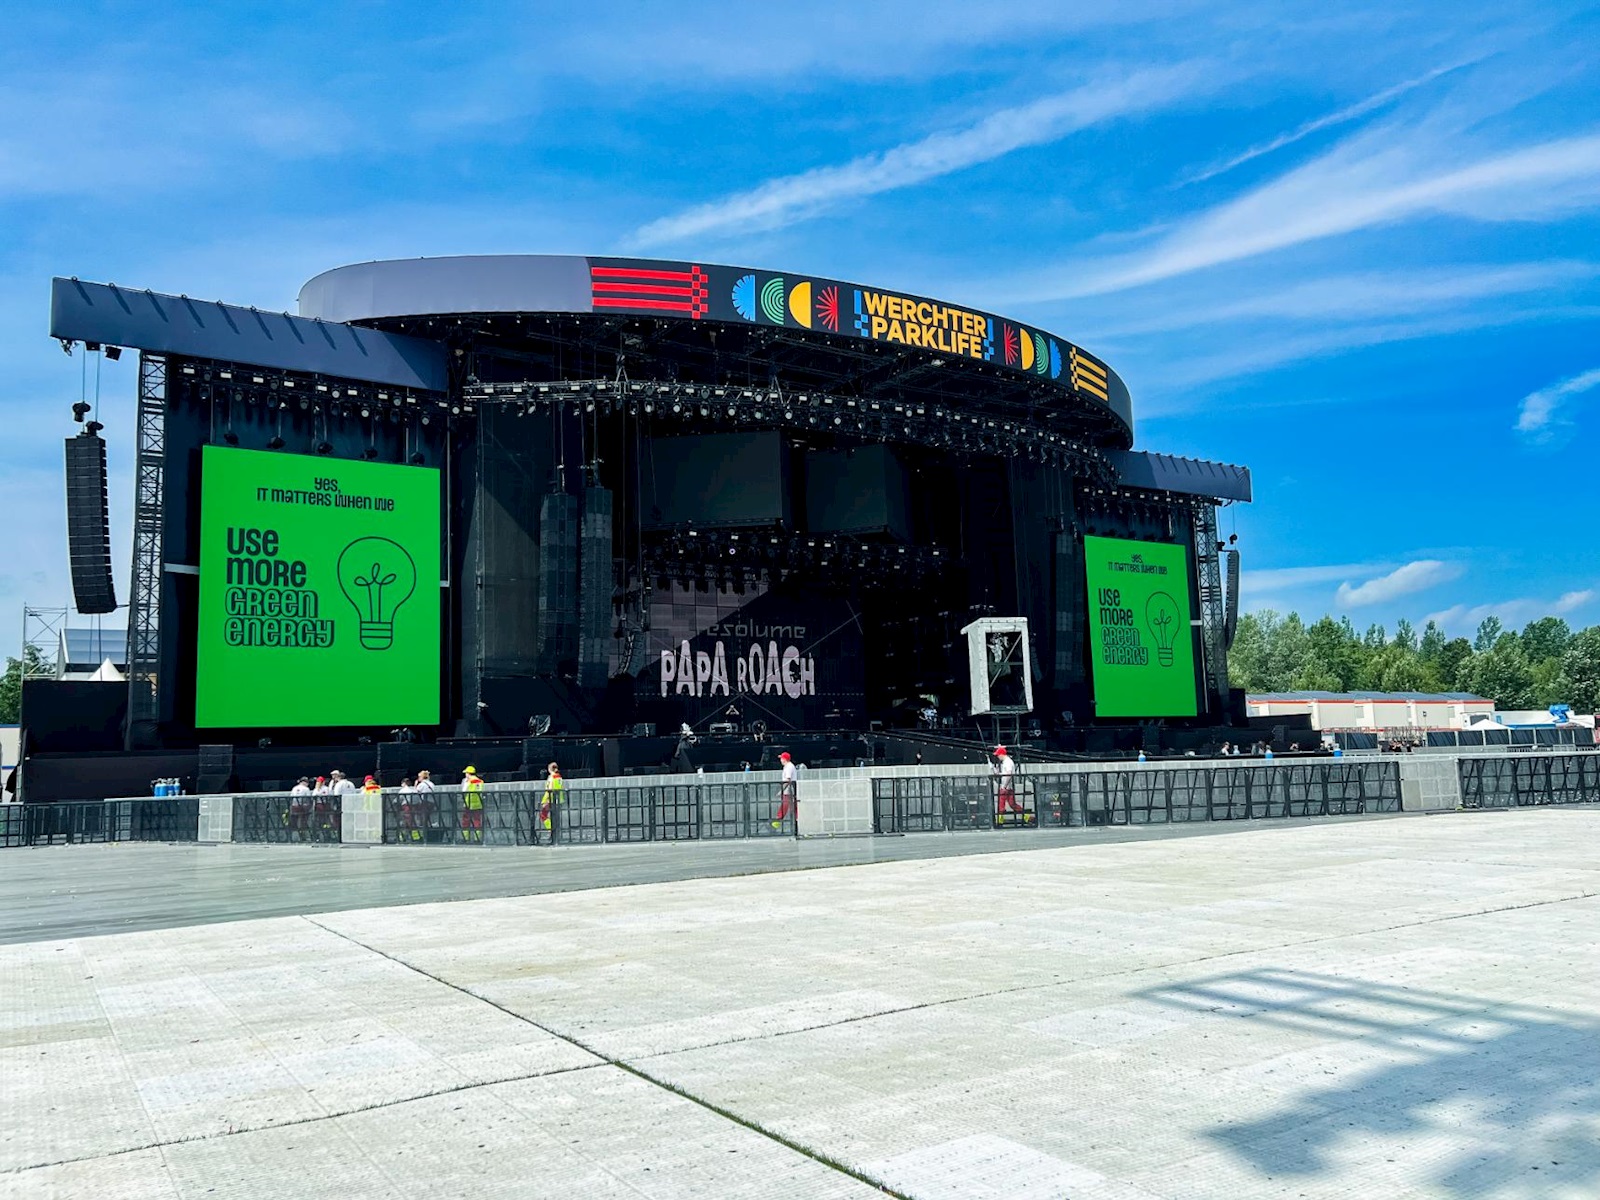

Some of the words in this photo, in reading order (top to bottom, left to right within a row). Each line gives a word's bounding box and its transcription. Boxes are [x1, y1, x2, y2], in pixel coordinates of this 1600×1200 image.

[863, 291, 987, 338] WERCHTER
[871, 315, 982, 359] PARKLIFE
[257, 487, 269, 502] IT
[697, 618, 807, 639] esolume
[660, 639, 730, 698] PAPA
[737, 640, 816, 699] ROACH
